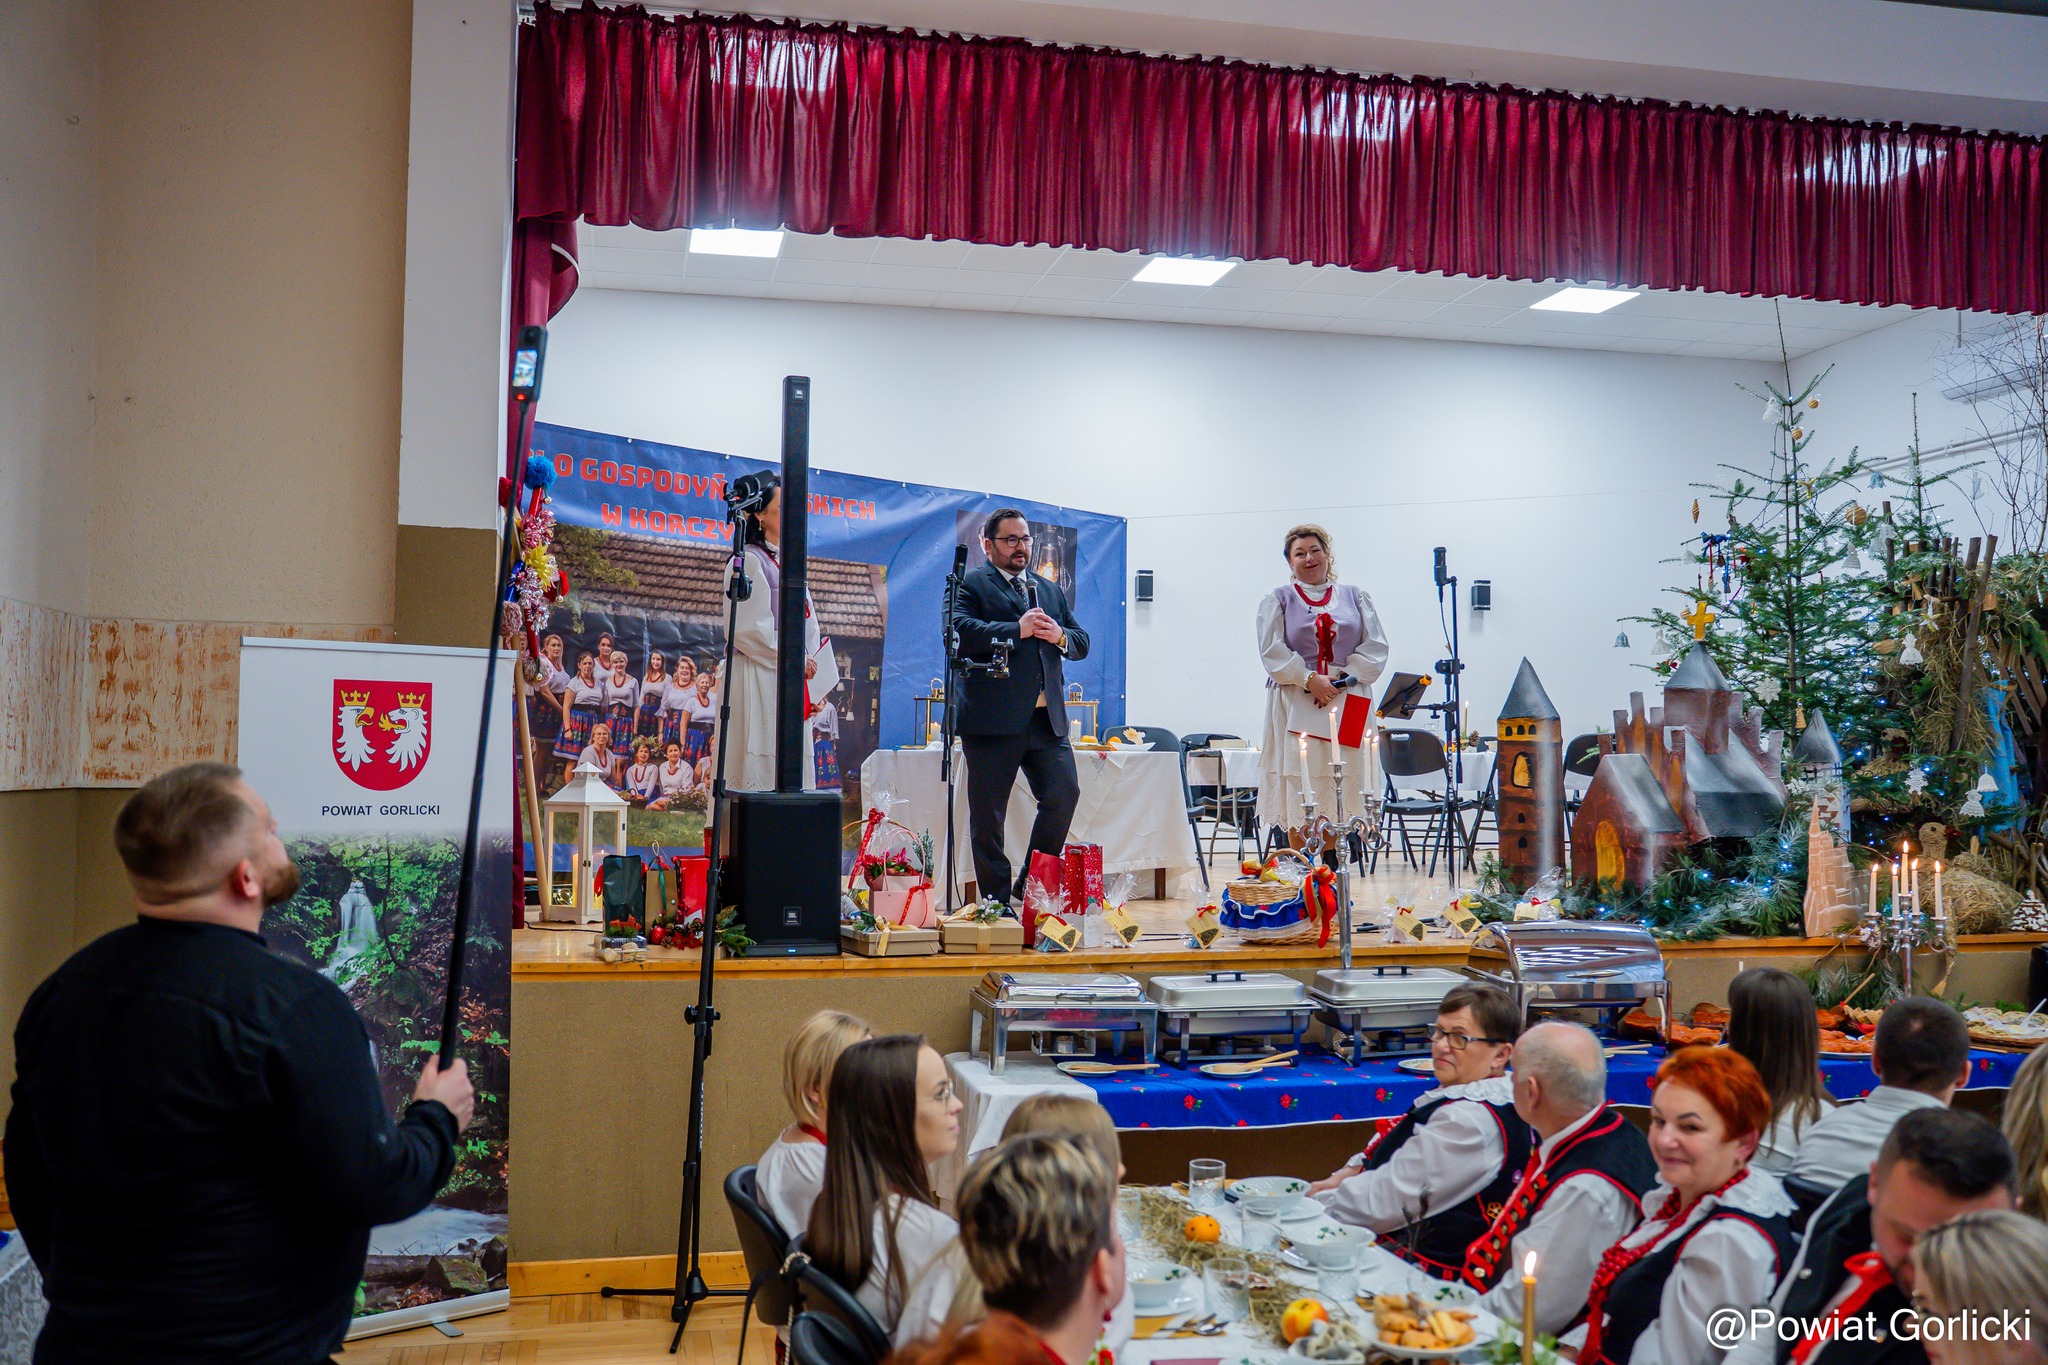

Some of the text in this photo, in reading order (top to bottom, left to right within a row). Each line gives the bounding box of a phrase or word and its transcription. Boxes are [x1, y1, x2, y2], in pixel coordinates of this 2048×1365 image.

[601, 503, 736, 542] W KORCZY
[321, 804, 440, 816] POWIAT GORLICKI
